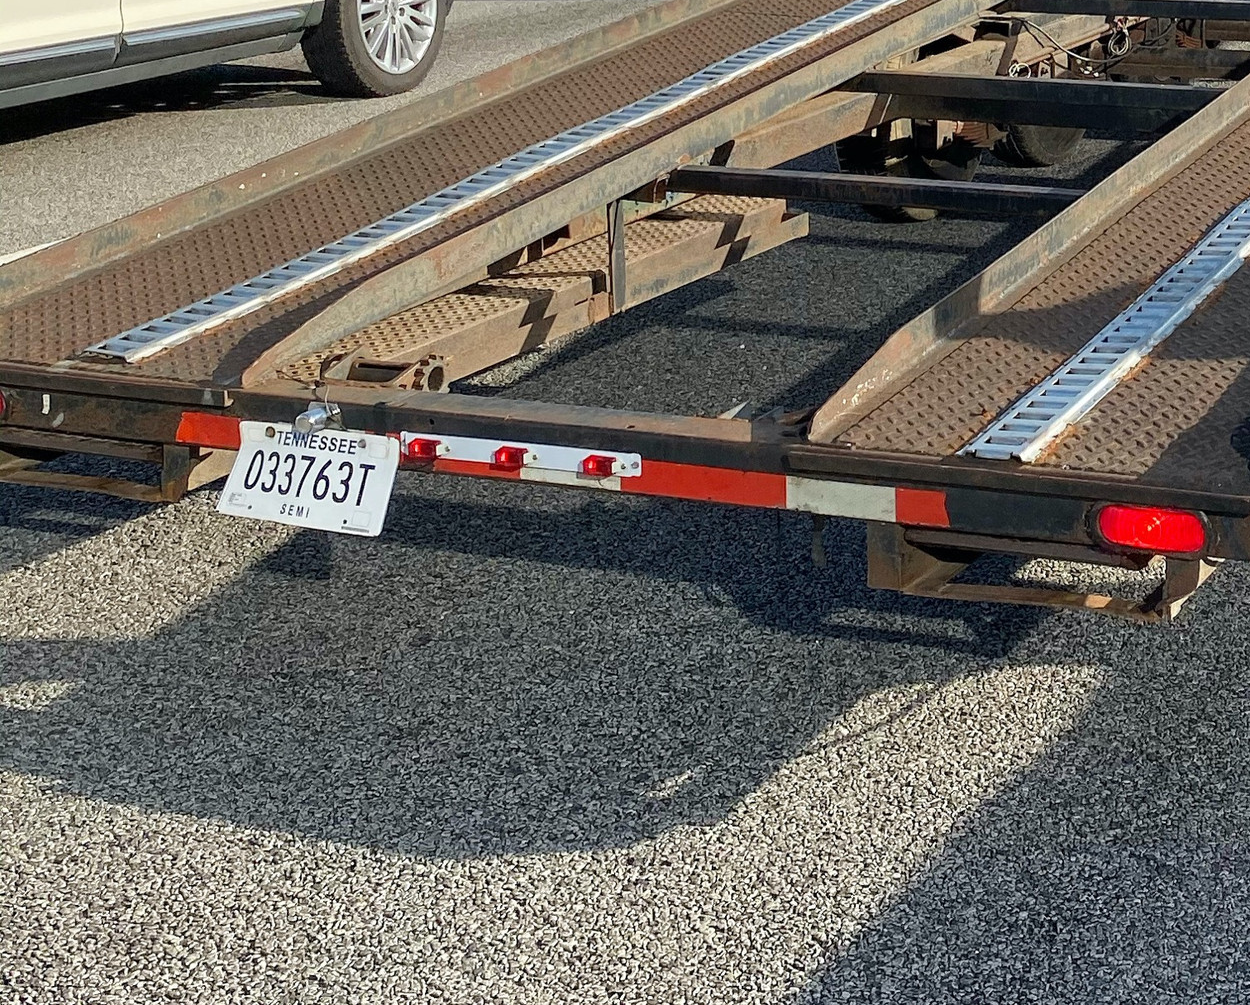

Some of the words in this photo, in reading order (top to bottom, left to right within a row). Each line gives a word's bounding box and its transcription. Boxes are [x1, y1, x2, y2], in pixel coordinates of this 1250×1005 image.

[276, 430, 359, 455] TENNESSEE
[243, 449, 376, 507] 033763T
[279, 503, 311, 519] SEMI
